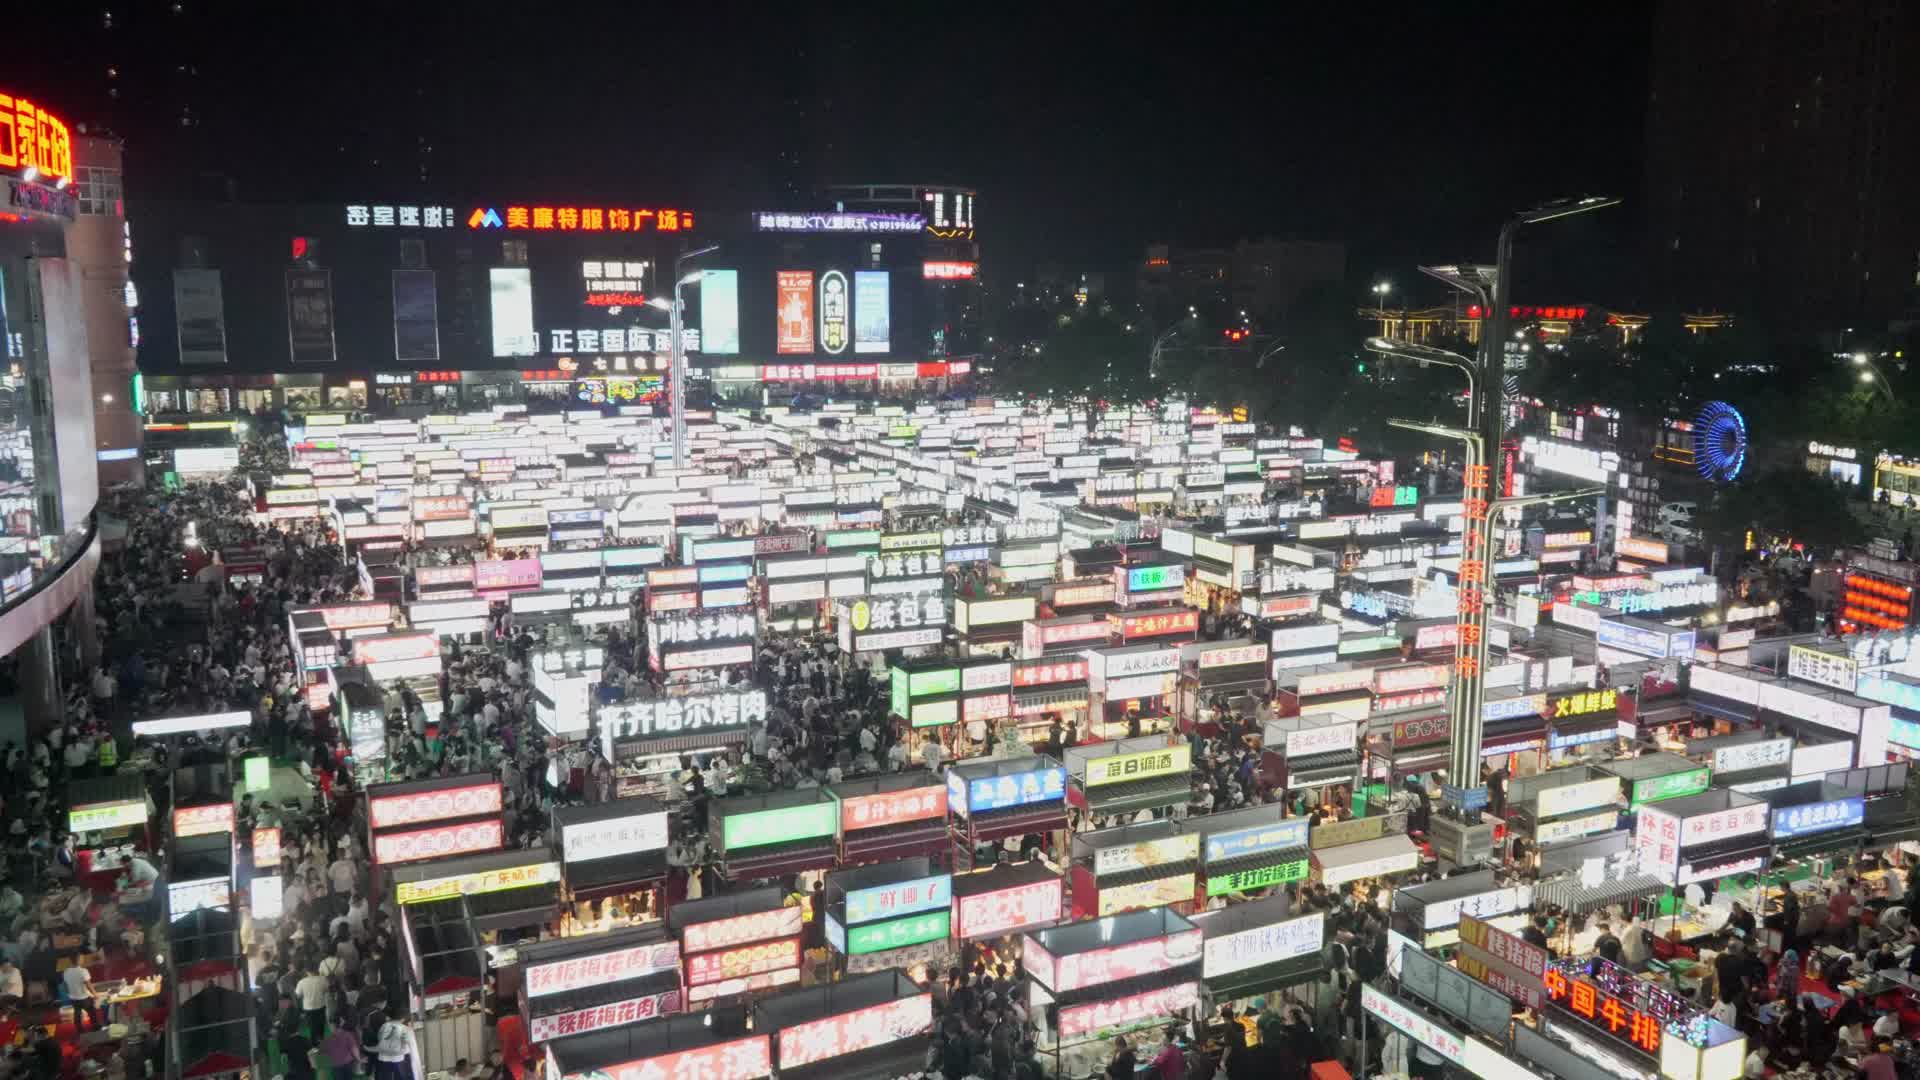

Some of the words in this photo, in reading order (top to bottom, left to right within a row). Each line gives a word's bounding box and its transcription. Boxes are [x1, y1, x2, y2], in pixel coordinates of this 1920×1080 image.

[871, 596, 947, 630] 纸包鱼
[1229, 863, 1303, 889] 手打柠檬茶
[531, 948, 648, 992] 铁板梅花肉
[558, 996, 656, 1035] 铁板梅花肉
[1544, 963, 1660, 1053] 中国牛排
